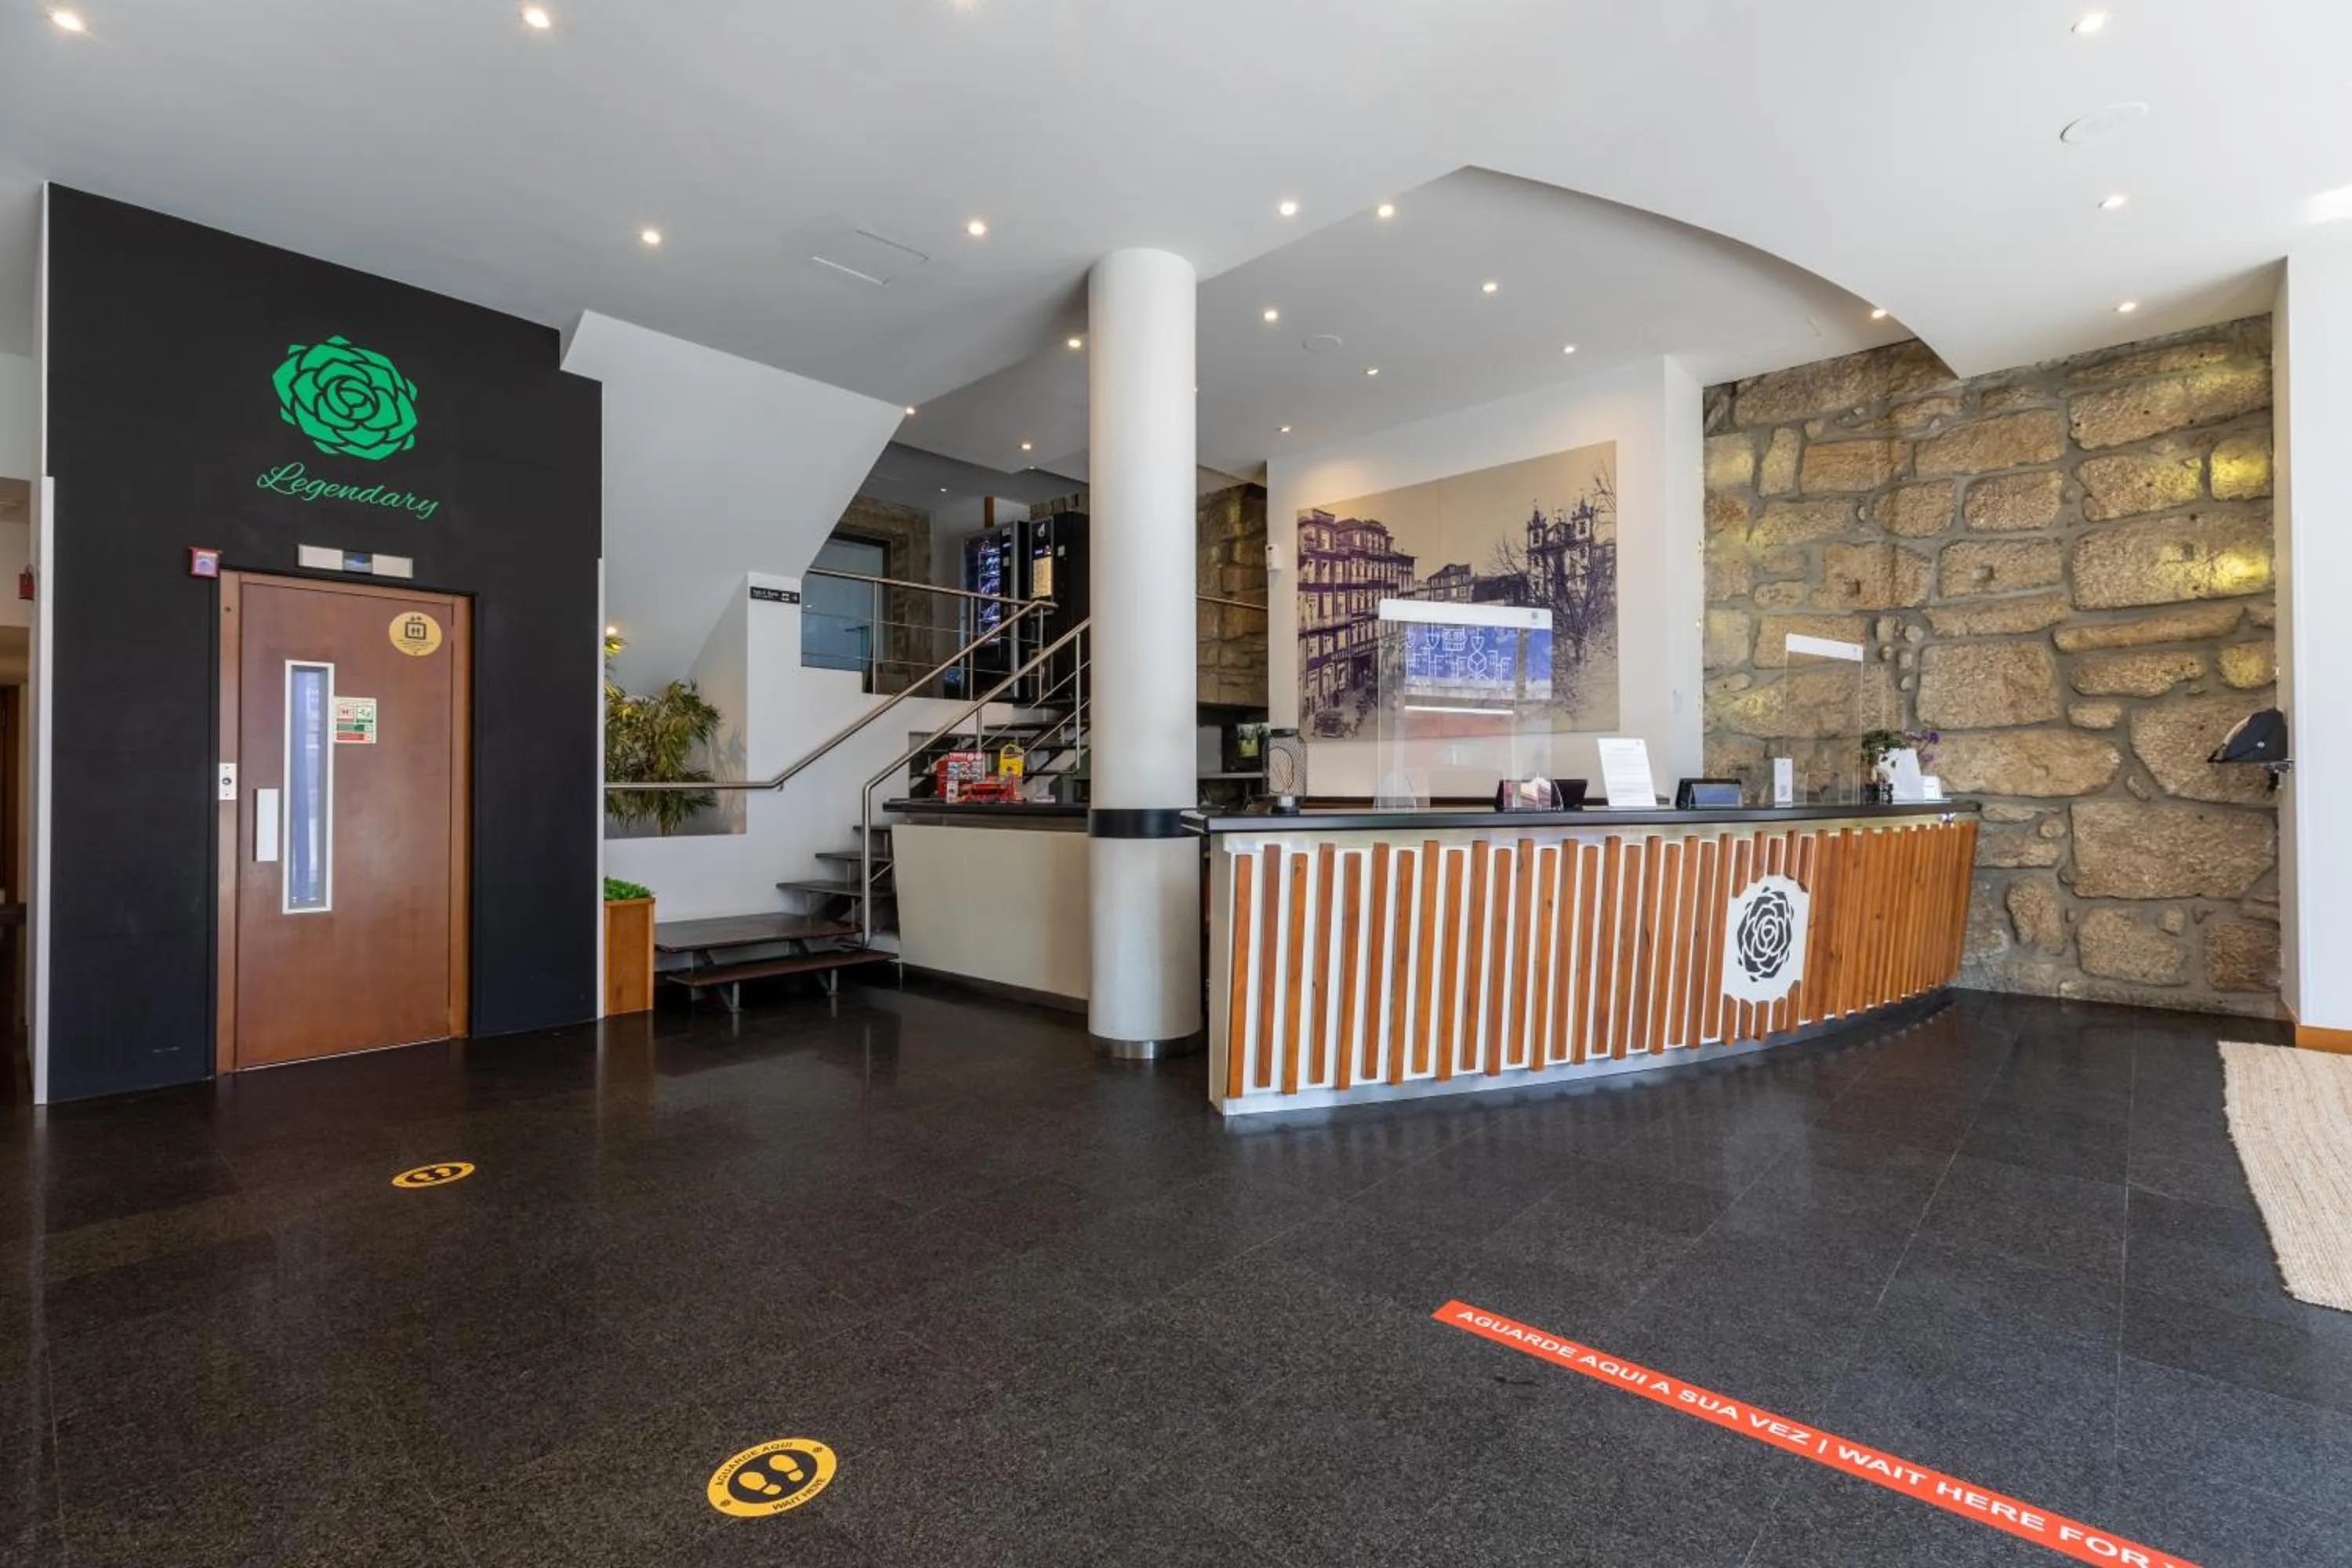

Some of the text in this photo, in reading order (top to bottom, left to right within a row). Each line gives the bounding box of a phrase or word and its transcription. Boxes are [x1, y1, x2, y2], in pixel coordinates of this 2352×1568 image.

[256, 462, 439, 519] Legendary
[715, 1442, 793, 1486] AGUARDE AQUI
[1457, 1312, 1576, 1358] AGUARDE
[1578, 1355, 1647, 1385] AQUI
[1650, 1381, 1669, 1394] A
[1679, 1389, 1738, 1419] SUA
[1749, 1414, 1810, 1445] VEZ
[1838, 1445, 1926, 1485] WAIT
[1936, 1481, 2045, 1531] HERE
[2060, 1526, 2151, 1568] FOR
[772, 1496, 801, 1511] WAIT
